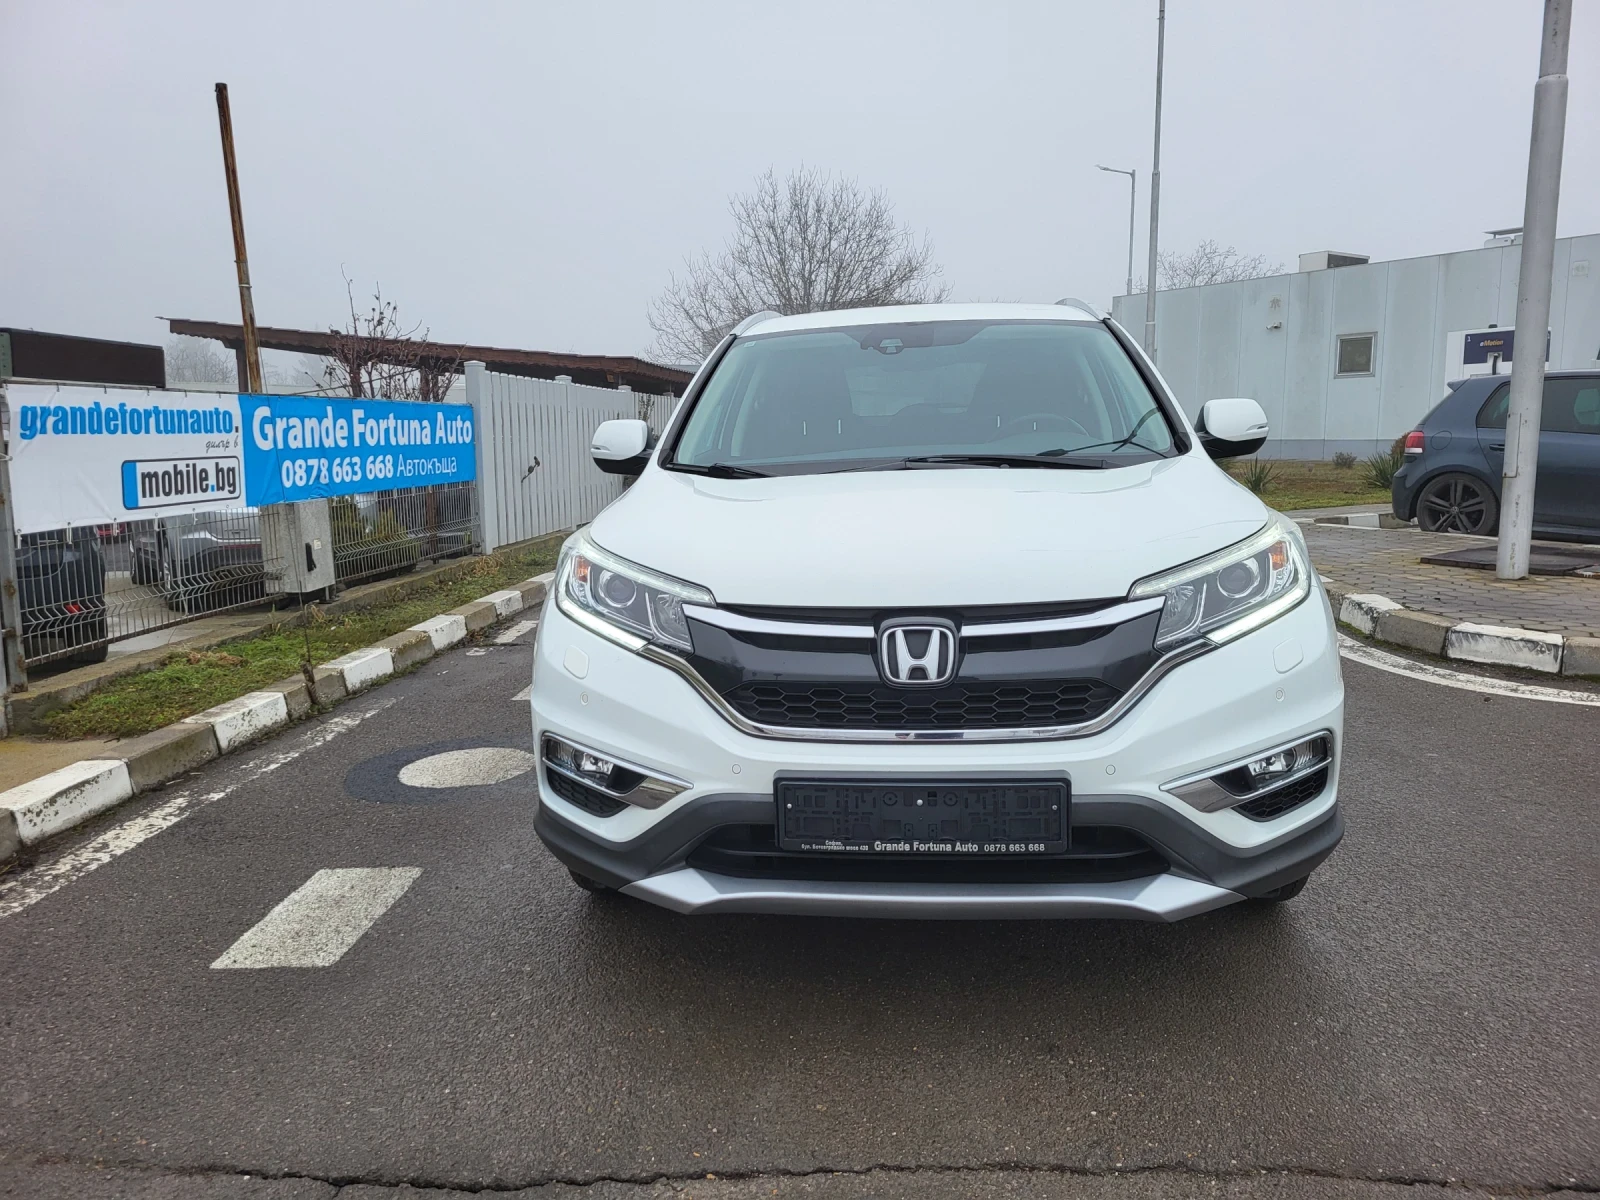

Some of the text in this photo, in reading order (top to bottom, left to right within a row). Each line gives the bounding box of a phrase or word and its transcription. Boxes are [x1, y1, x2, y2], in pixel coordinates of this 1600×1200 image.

[252, 405, 473, 451] Grande Fortuna Auto
[141, 461, 237, 499] mobile.bg
[281, 453, 457, 488] 0878 663 668 Автокъща
[874, 841, 1045, 852] Grande Fortuna Auto 0878 663 668
